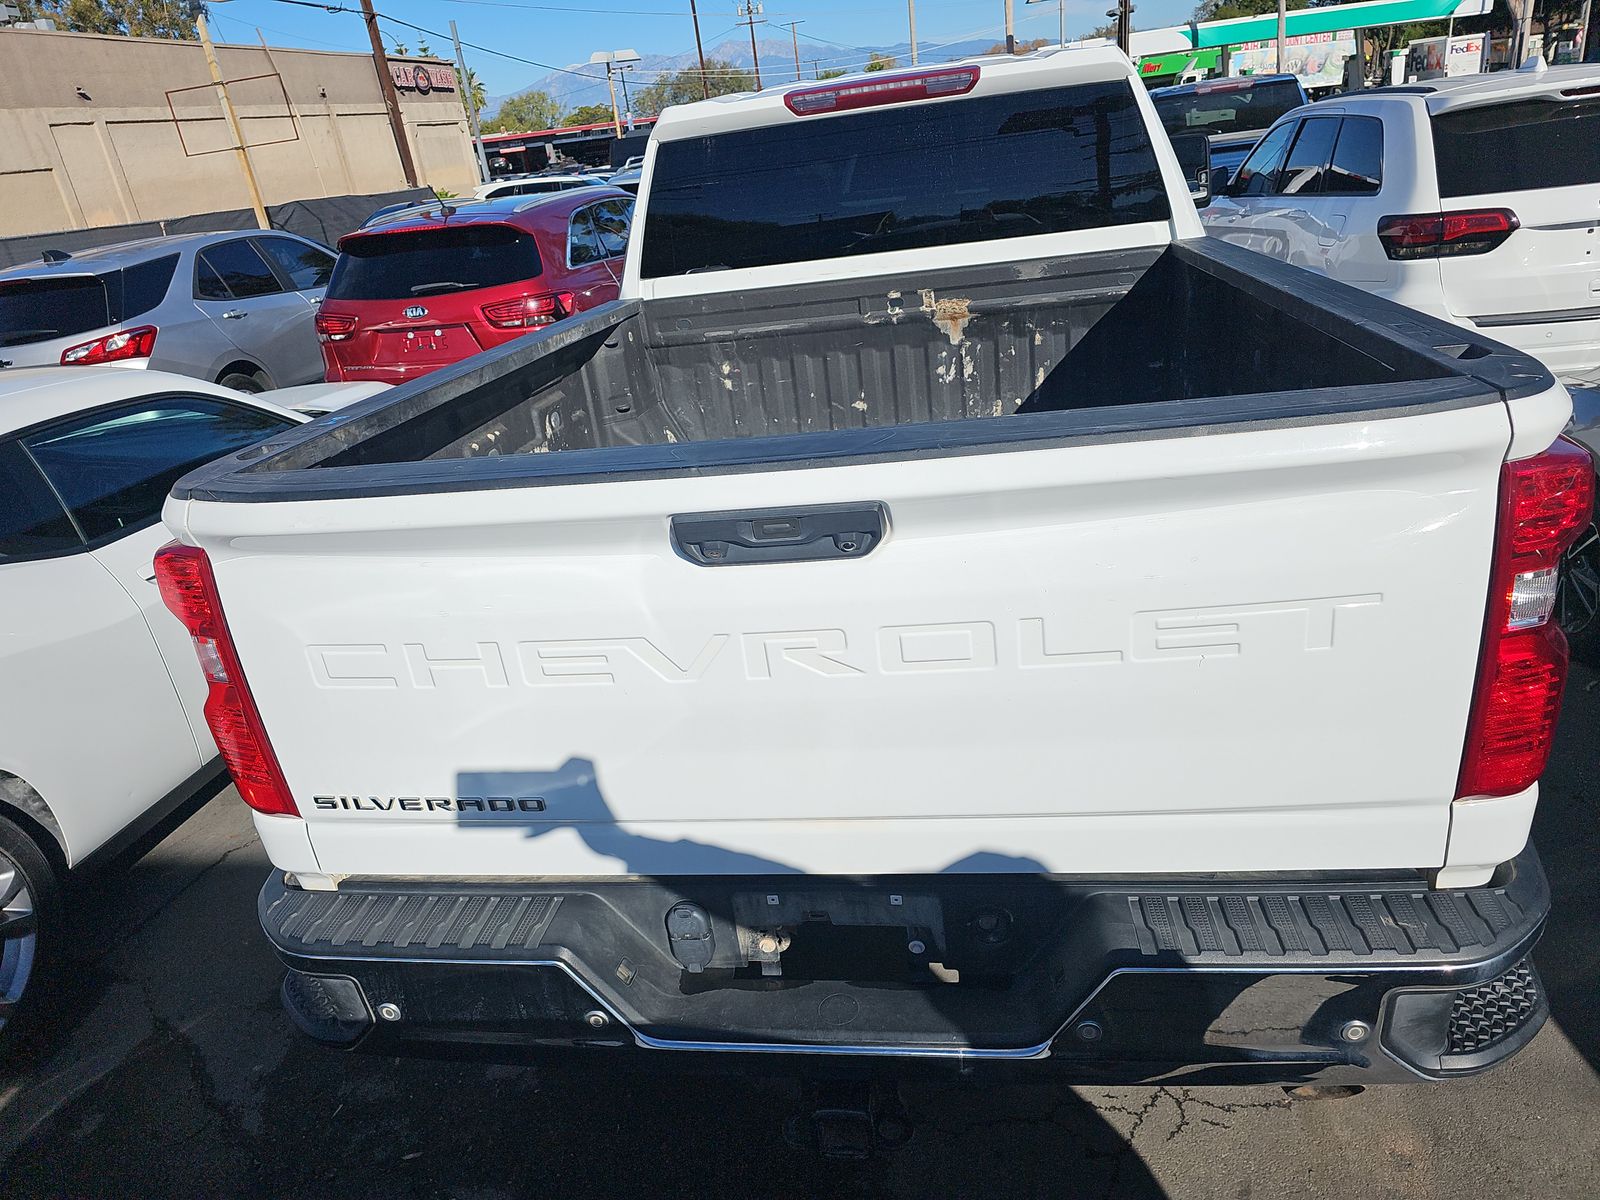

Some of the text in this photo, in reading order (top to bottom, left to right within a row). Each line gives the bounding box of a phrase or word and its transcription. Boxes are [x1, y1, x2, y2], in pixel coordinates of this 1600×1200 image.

[1410, 43, 1443, 72] FedEx
[1450, 42, 1480, 54] FedEx
[392, 66, 454, 88] CAR WASH
[405, 306, 425, 317] KIA
[305, 592, 1383, 689] CHEVROLET
[312, 794, 547, 812] SILVERADO
